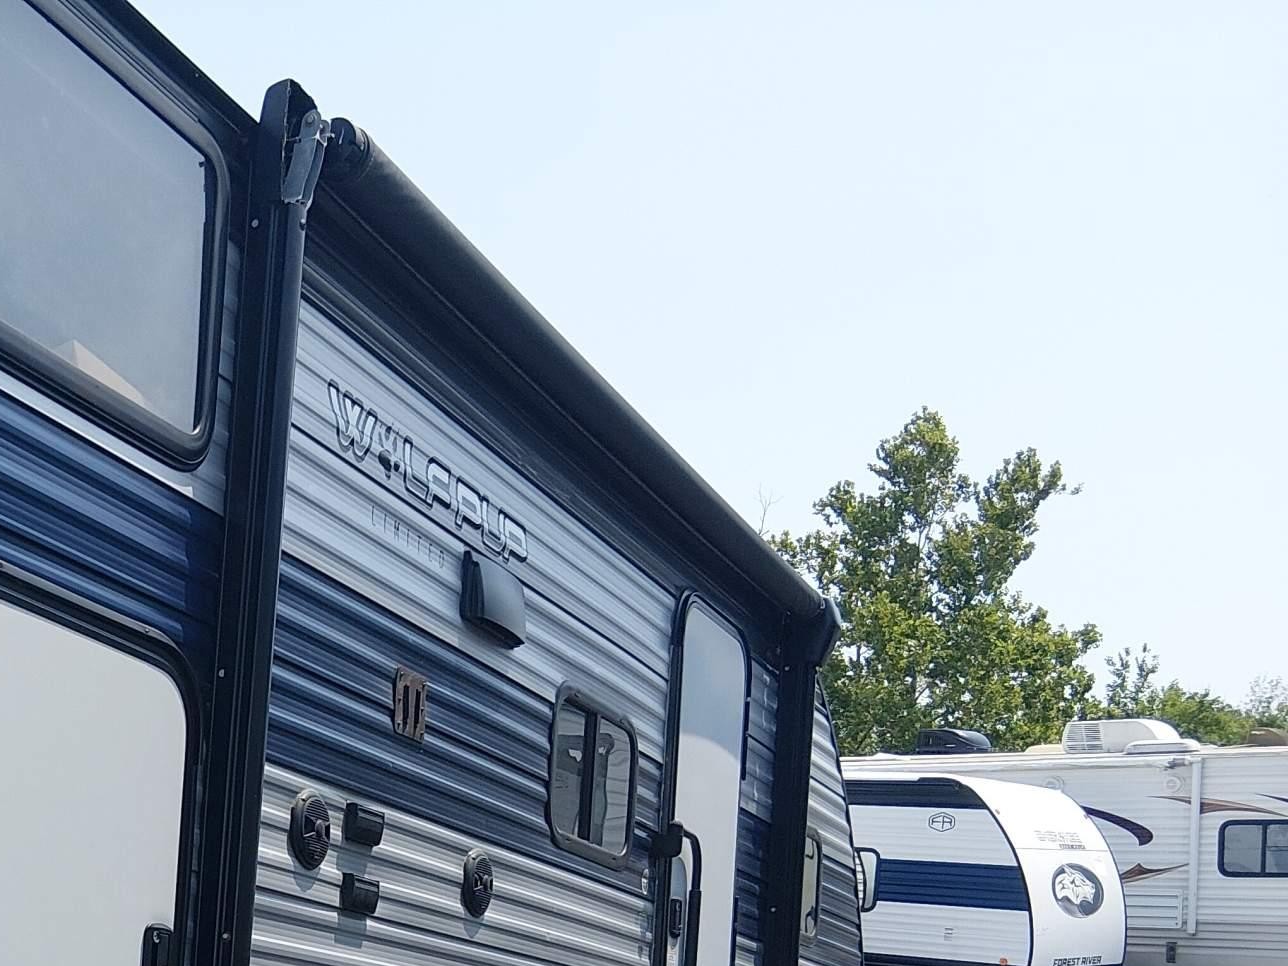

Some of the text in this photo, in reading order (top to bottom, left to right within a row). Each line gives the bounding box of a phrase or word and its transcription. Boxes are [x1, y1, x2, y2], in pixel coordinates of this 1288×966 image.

[455, 476, 528, 564] PUP
[1052, 955, 1102, 966] FOREST RIVER
